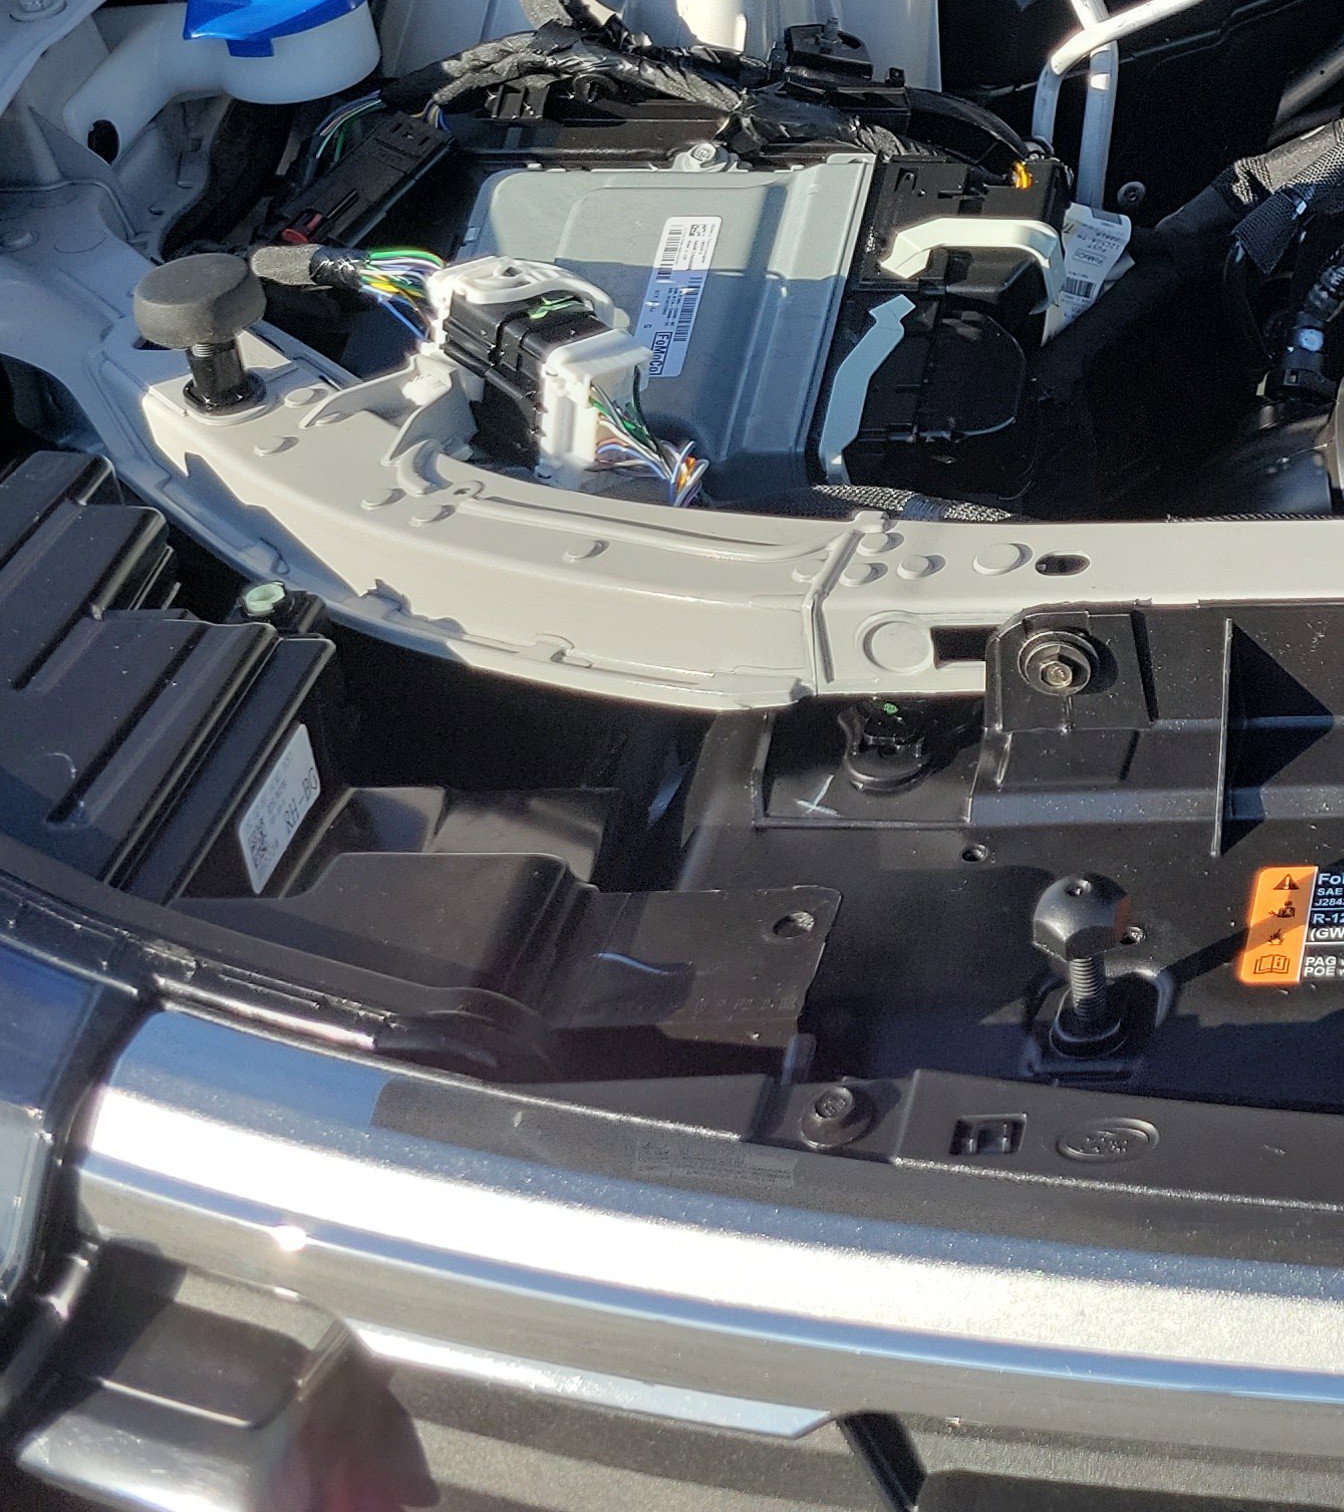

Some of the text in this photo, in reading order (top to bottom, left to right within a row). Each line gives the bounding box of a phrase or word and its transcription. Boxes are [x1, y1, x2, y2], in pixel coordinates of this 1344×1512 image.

[649, 333, 671, 373] FoMoCo
[1316, 887, 1343, 897] SAE
[1305, 956, 1337, 967] PAG
[1304, 966, 1336, 977] POE
